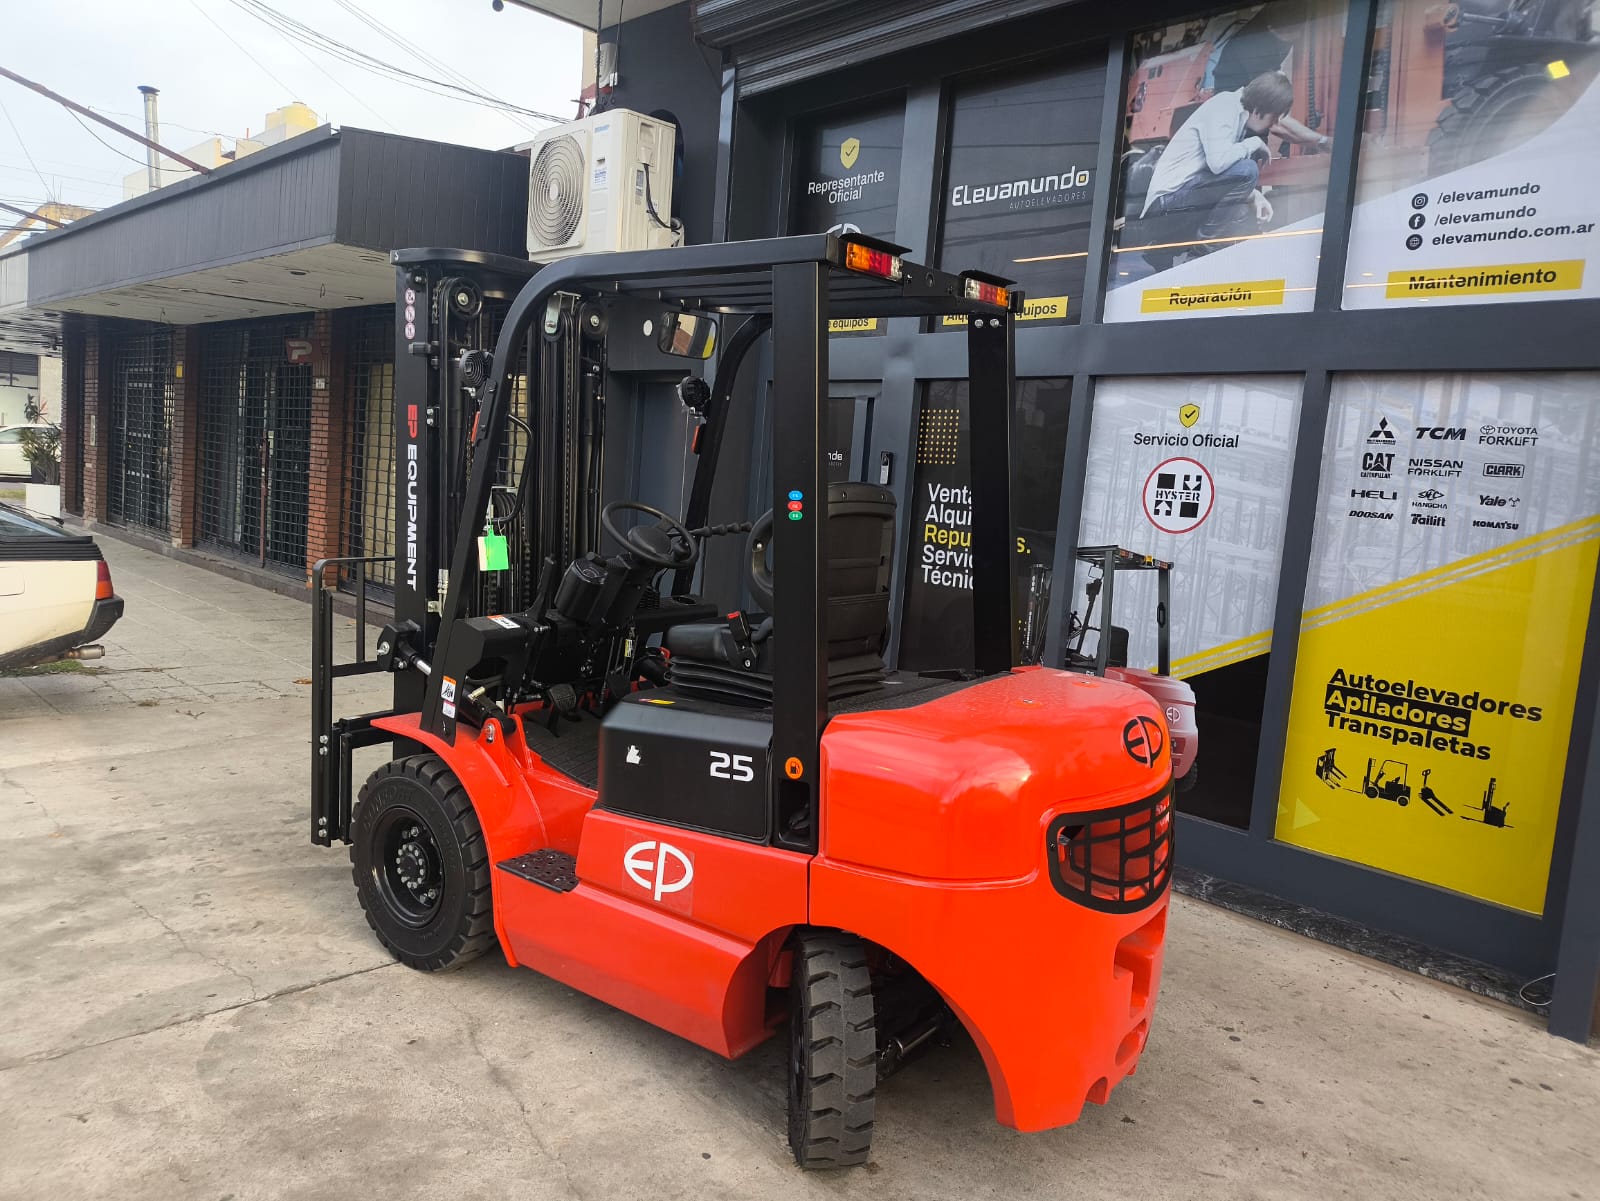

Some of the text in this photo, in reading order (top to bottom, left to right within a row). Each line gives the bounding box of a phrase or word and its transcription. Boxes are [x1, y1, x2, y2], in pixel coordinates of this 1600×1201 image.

[807, 168, 885, 196] Representante
[952, 165, 1090, 208] Elevamundo
[827, 185, 863, 204] Oficial
[1008, 190, 1088, 211] AUTOELEVADORES
[1437, 181, 1541, 206] /elevamundo
[1434, 204, 1537, 228] /elevamundo
[1432, 220, 1595, 247] elevamundo.com.ar
[1408, 266, 1557, 292] Mantenimiento
[1169, 286, 1252, 308] Reparación
[1016, 303, 1058, 319] quipos
[1416, 426, 1466, 441] TCM
[1497, 426, 1538, 435] TOYOTA
[1133, 433, 1240, 449] Servicio Oficial
[1362, 452, 1396, 472] CAT
[1408, 458, 1464, 469] NISSAN
[1486, 465, 1522, 477] CLARK
[1407, 467, 1463, 478] FORKLIFT
[407, 404, 419, 592] EP EQUIPMENT
[1155, 489, 1201, 502] HYSTER
[1350, 488, 1398, 501] HELI
[1479, 494, 1507, 507] Yale
[1348, 510, 1394, 520] DOOSAN
[1411, 501, 1448, 510] HANGCHA
[1410, 513, 1447, 527] Tailift
[1472, 520, 1520, 530] KOMATSU
[1328, 668, 1543, 723] Autoelevadores
[1326, 689, 1468, 733] Apiladores
[1123, 715, 1164, 769] EP
[1325, 710, 1492, 761] Transpaletas
[709, 750, 755, 783] 25
[623, 840, 694, 902] EP
